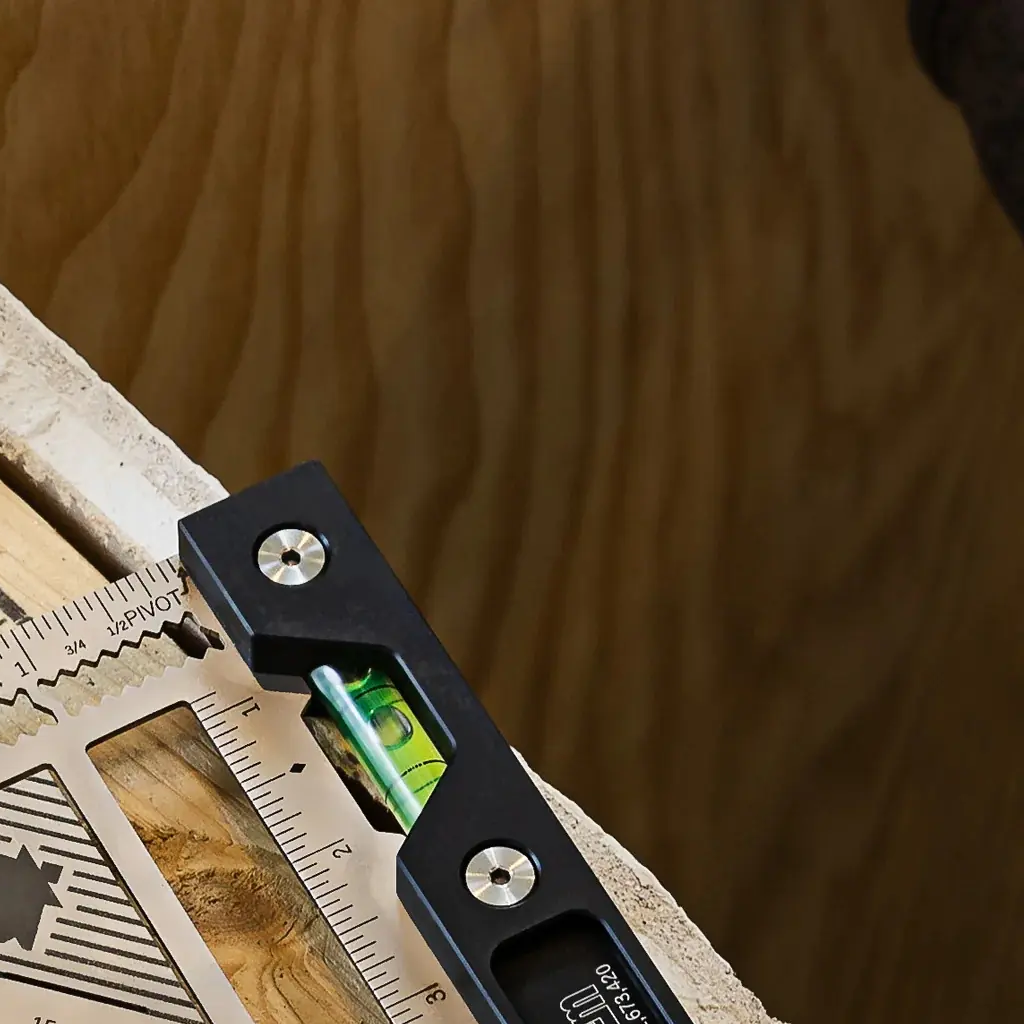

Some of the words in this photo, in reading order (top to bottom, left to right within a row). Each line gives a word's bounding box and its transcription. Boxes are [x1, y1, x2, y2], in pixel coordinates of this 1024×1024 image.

[123, 588, 182, 627] PIVOT
[14, 661, 30, 678] 1
[64, 639, 87, 655] 3/4
[106, 620, 129, 637] 1/2
[241, 702, 261, 717] 1
[332, 844, 353, 859] 2
[425, 989, 447, 1005] 3
